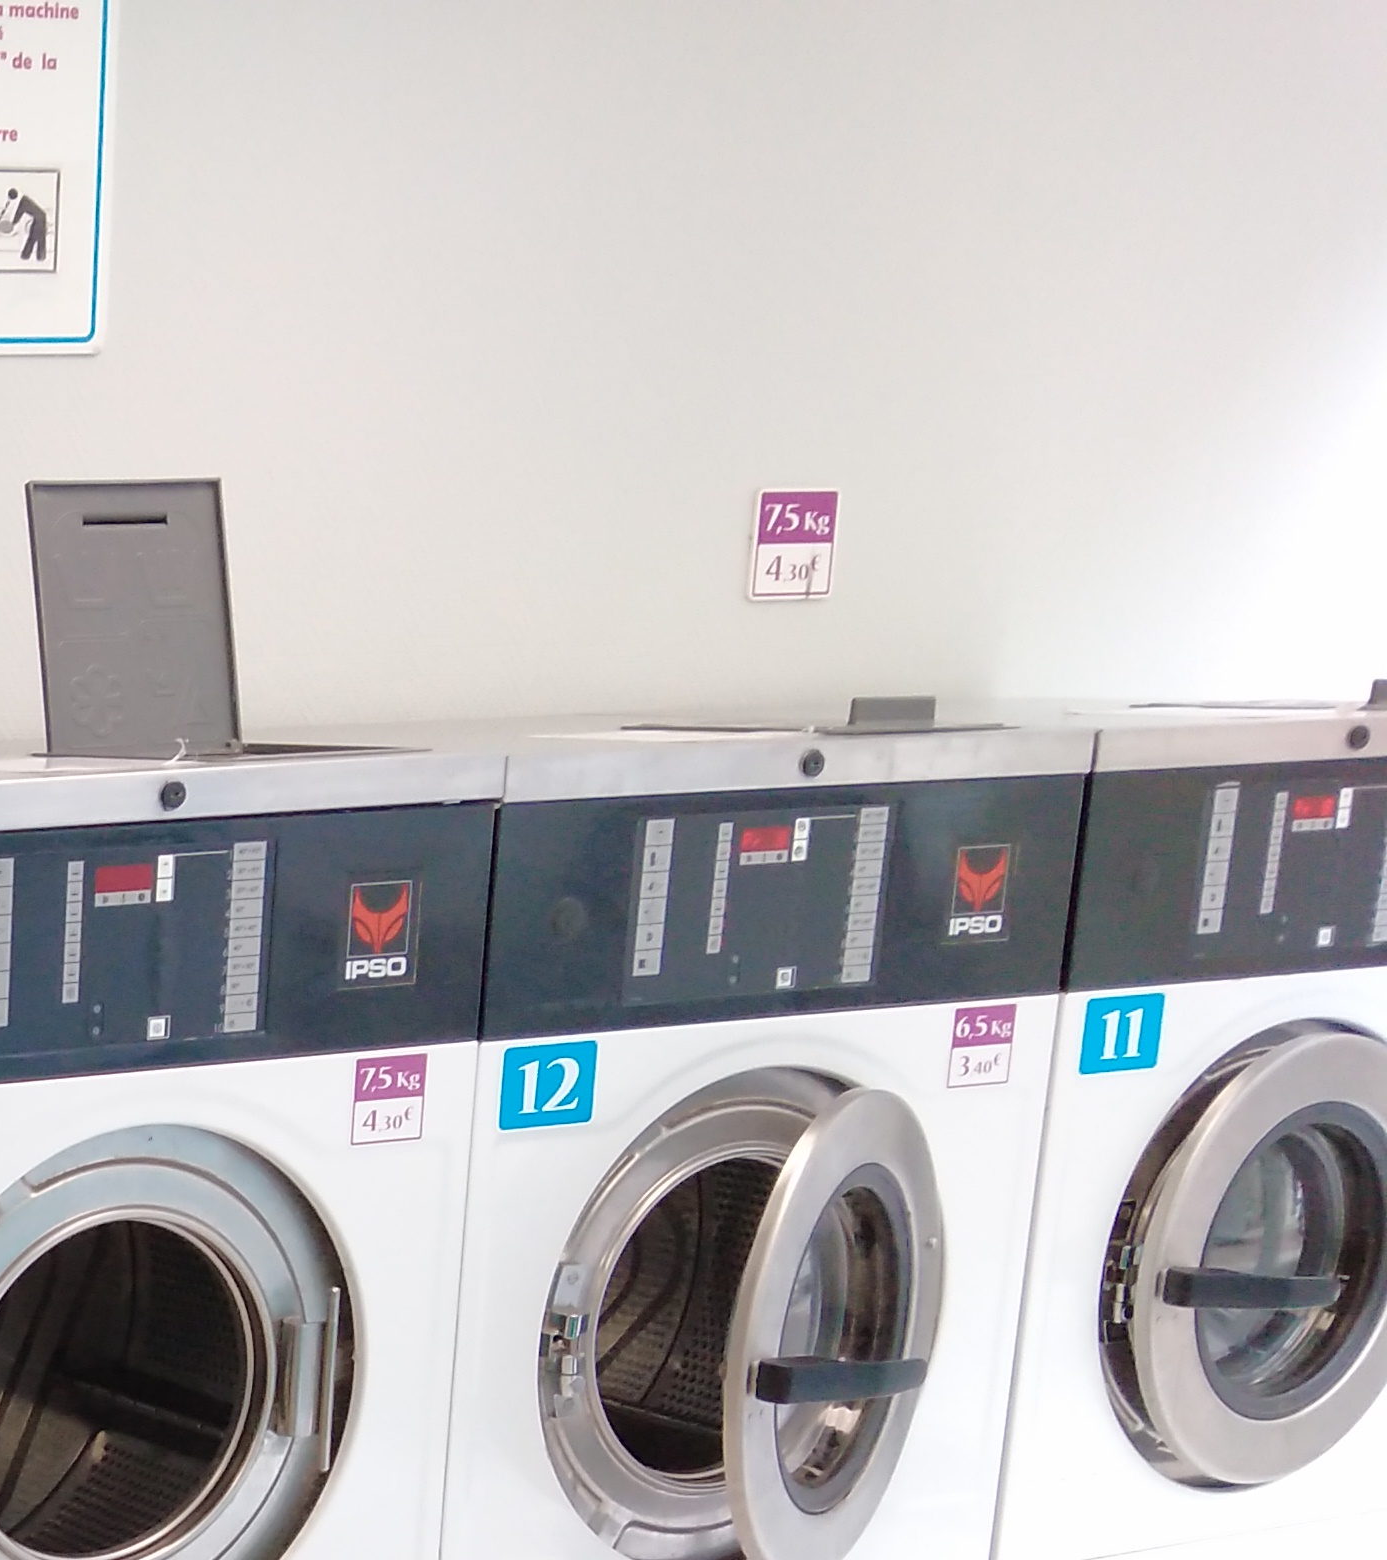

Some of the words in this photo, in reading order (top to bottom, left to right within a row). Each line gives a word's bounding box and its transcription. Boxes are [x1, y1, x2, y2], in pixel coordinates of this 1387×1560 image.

[9, 1, 79, 20] machine
[12, 51, 33, 70] de
[41, 52, 57, 70] la
[765, 504, 801, 535] 7,5
[803, 511, 831, 535] Kg
[949, 914, 1002, 936] IPSO
[345, 956, 407, 981] IPSO
[956, 1015, 989, 1040] 6,5
[992, 1019, 1014, 1039] Kg
[1100, 1008, 1144, 1060] 11
[360, 1066, 392, 1093] 7,5
[397, 1070, 421, 1091] Kg
[518, 1057, 580, 1114] 12
